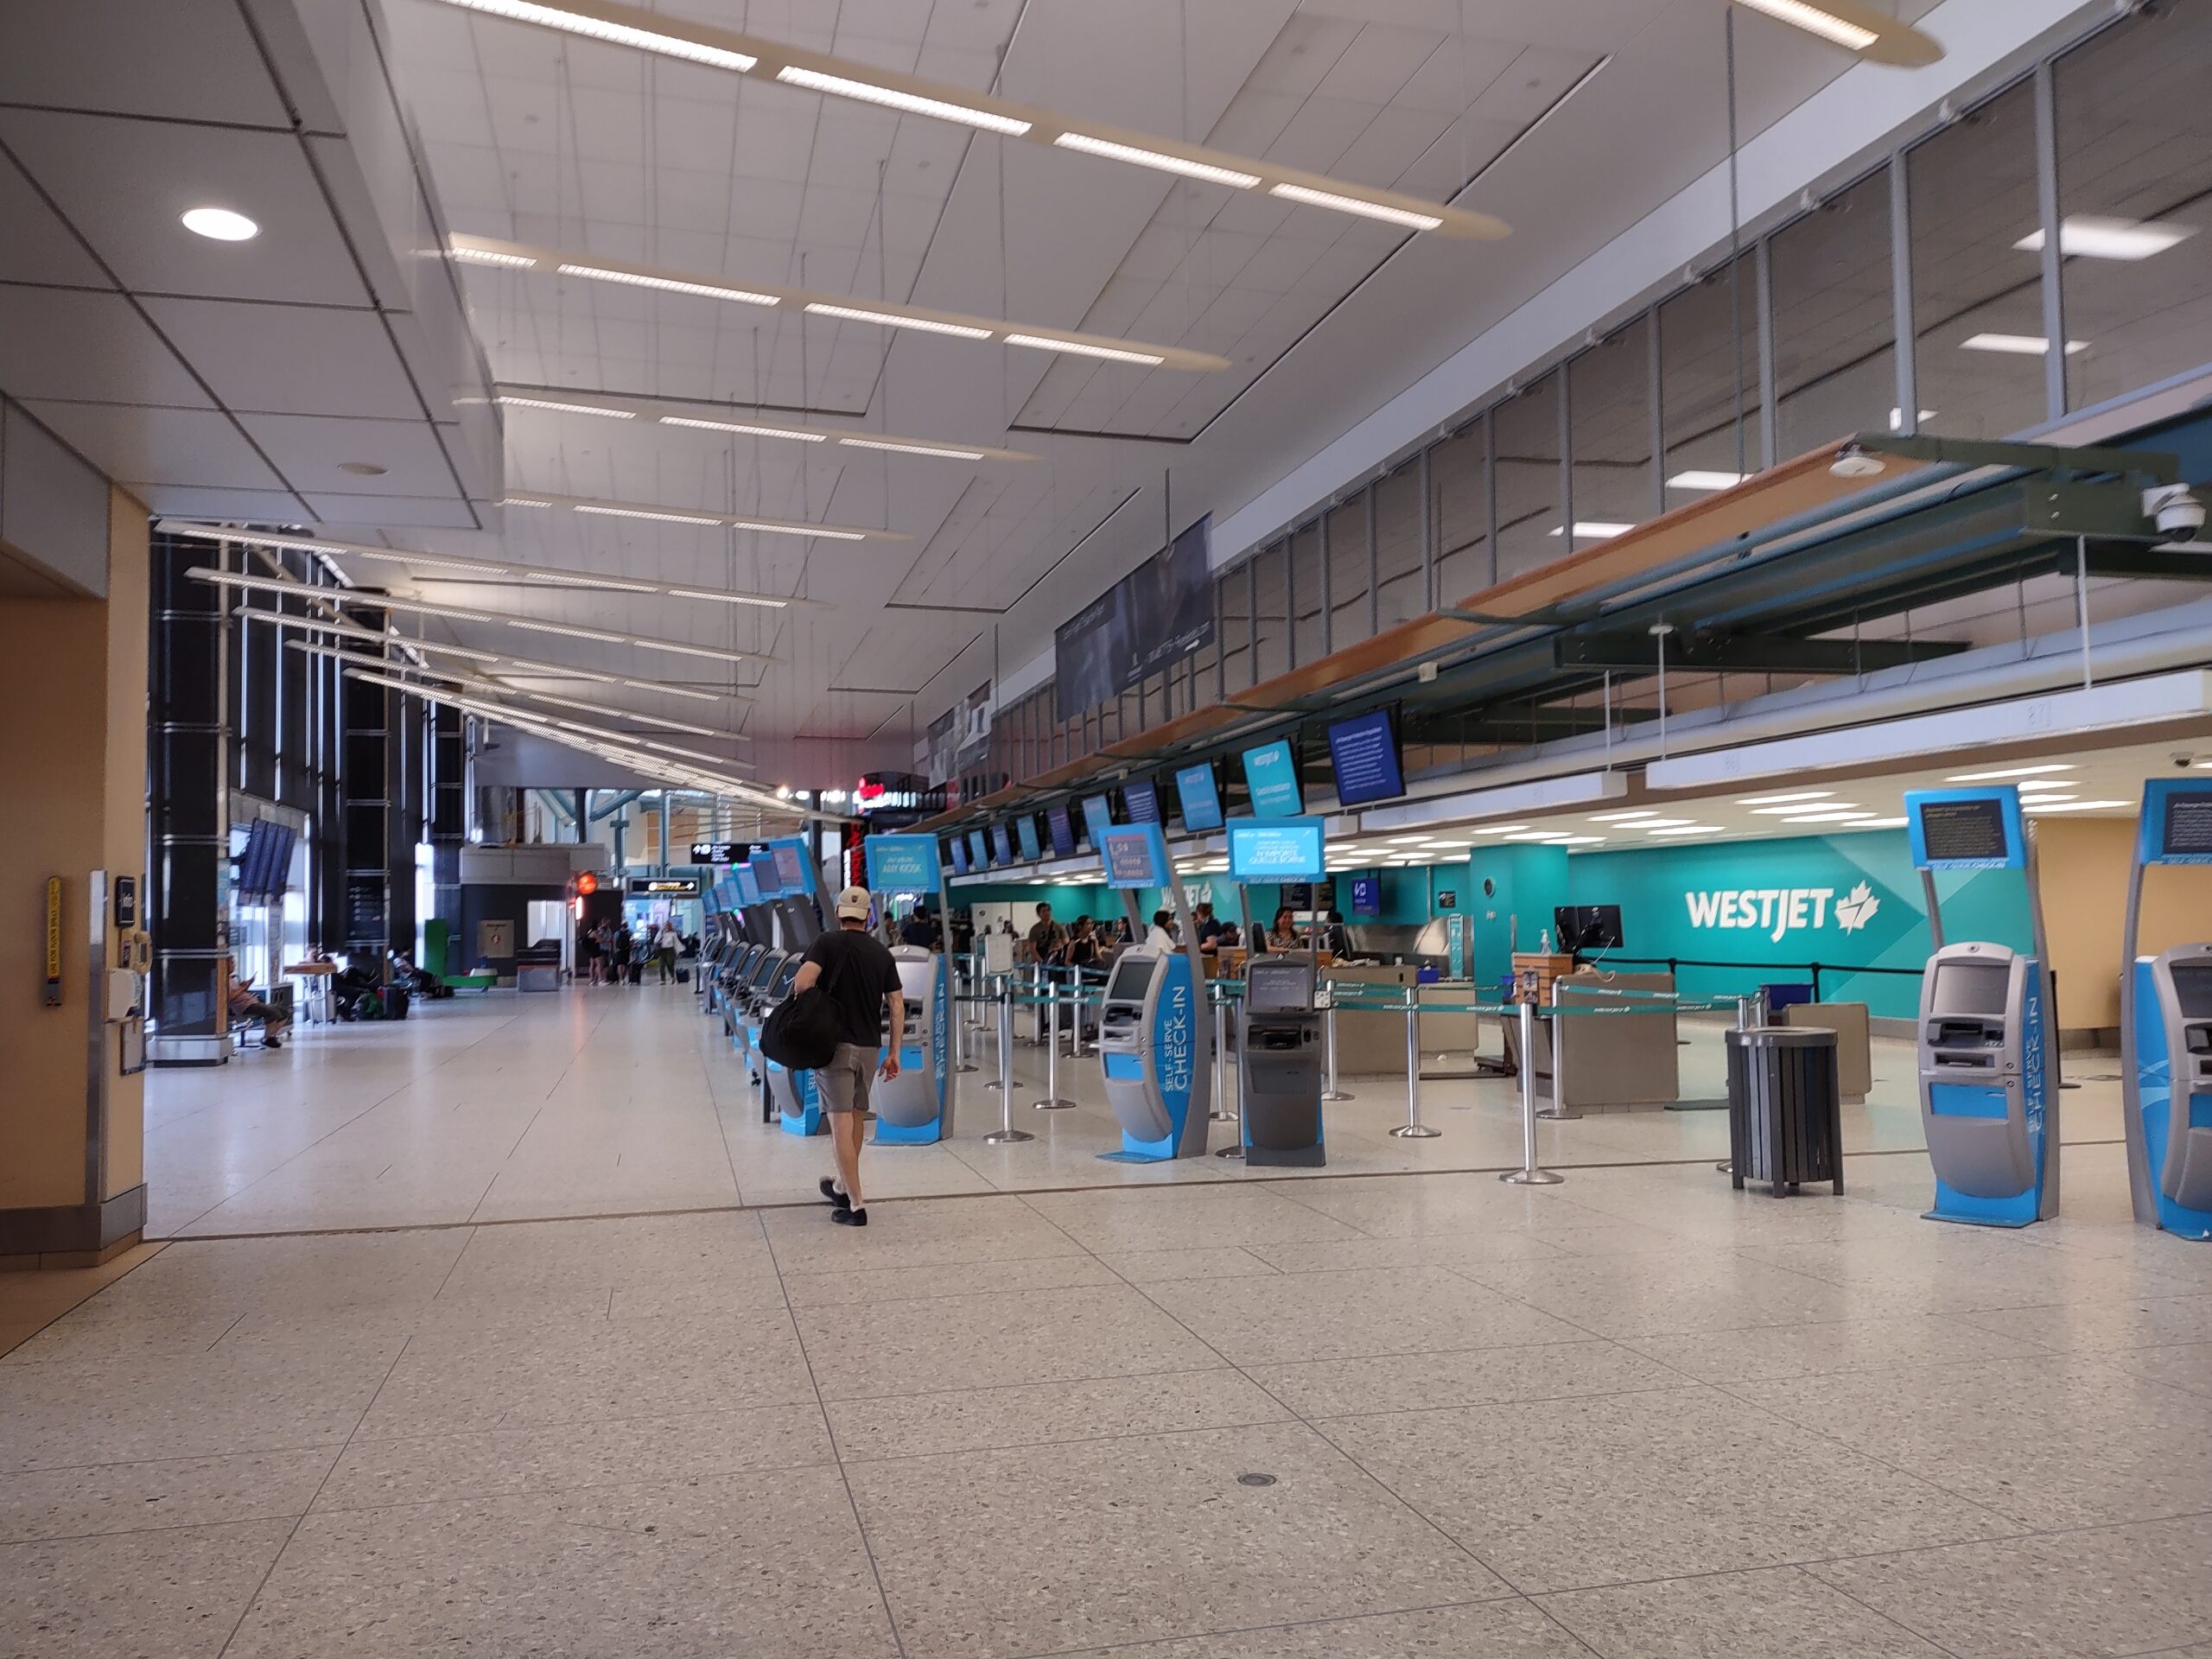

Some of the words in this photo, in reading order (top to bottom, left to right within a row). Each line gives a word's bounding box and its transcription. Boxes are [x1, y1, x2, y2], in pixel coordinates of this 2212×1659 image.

[1686, 887, 1834, 944] WESTJET
[1164, 1019, 1173, 1092] SELF-SERVE
[1173, 985, 1187, 1090] CHECK-IN
[2029, 997, 2043, 1131] CHECK-IN
